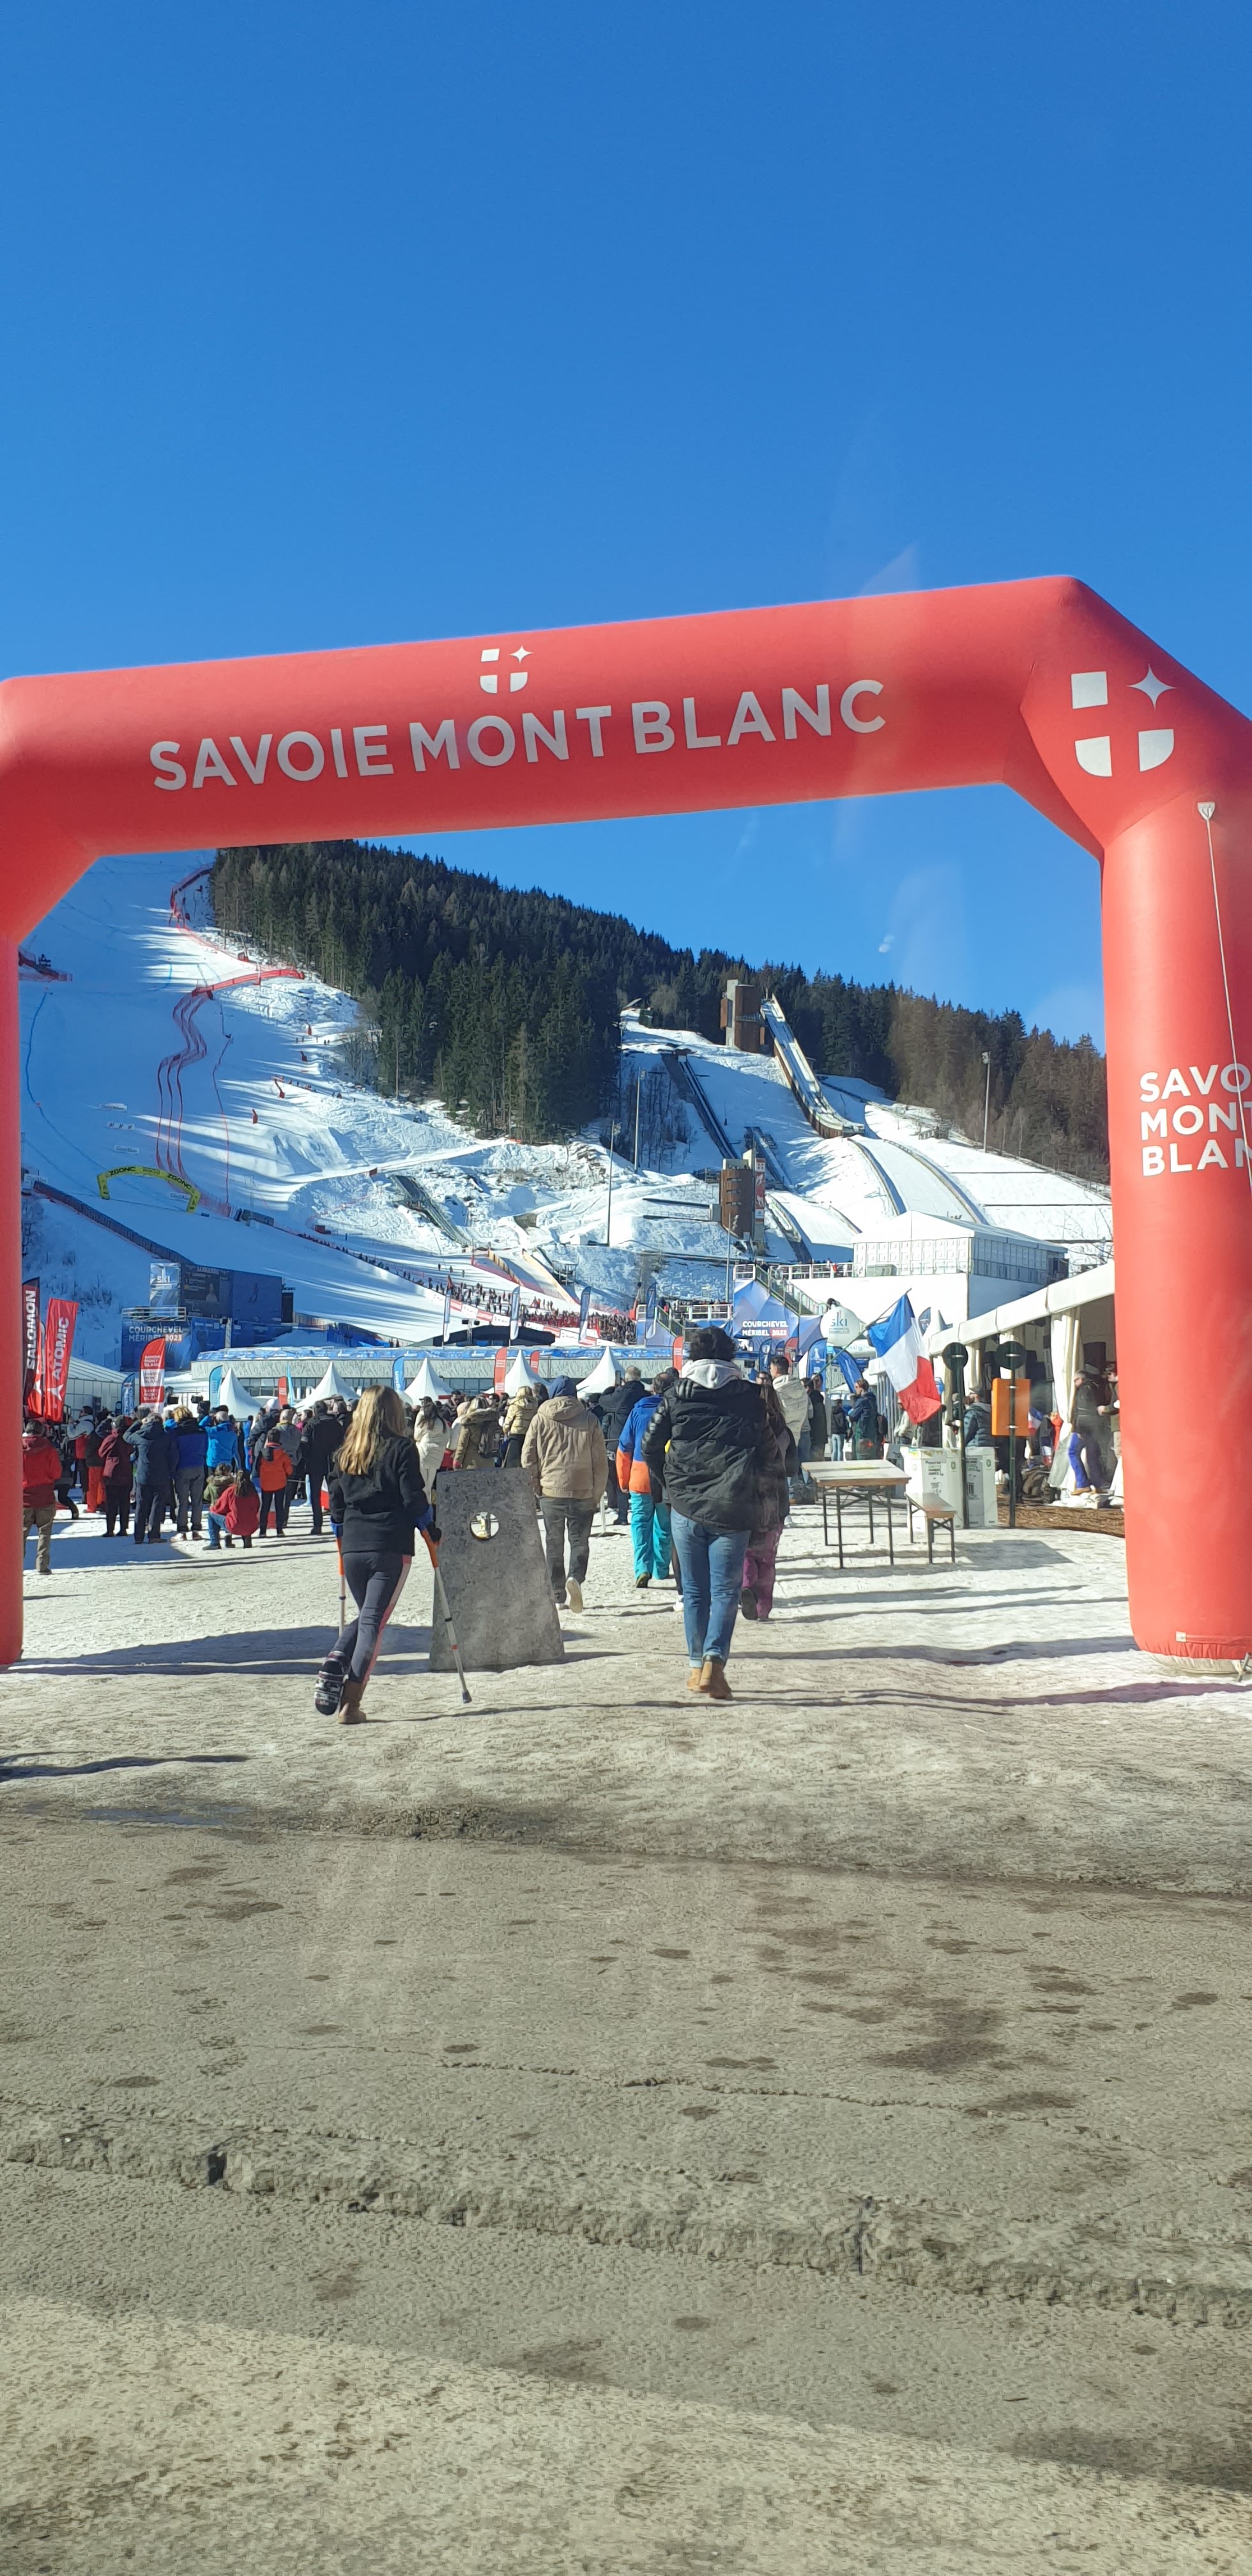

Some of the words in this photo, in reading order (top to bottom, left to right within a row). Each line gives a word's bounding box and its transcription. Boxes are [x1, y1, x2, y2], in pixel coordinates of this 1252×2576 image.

[149, 724, 394, 791] SAVOIE
[409, 705, 612, 772] MONT
[631, 679, 887, 754] BLANC
[109, 1167, 136, 1176] ZGONC
[167, 1173, 192, 1190] ZGONC
[26, 1290, 37, 1370] SALOMON
[52, 1317, 70, 1381] ATOMIC
[129, 1326, 183, 1334] COURCHEVEL
